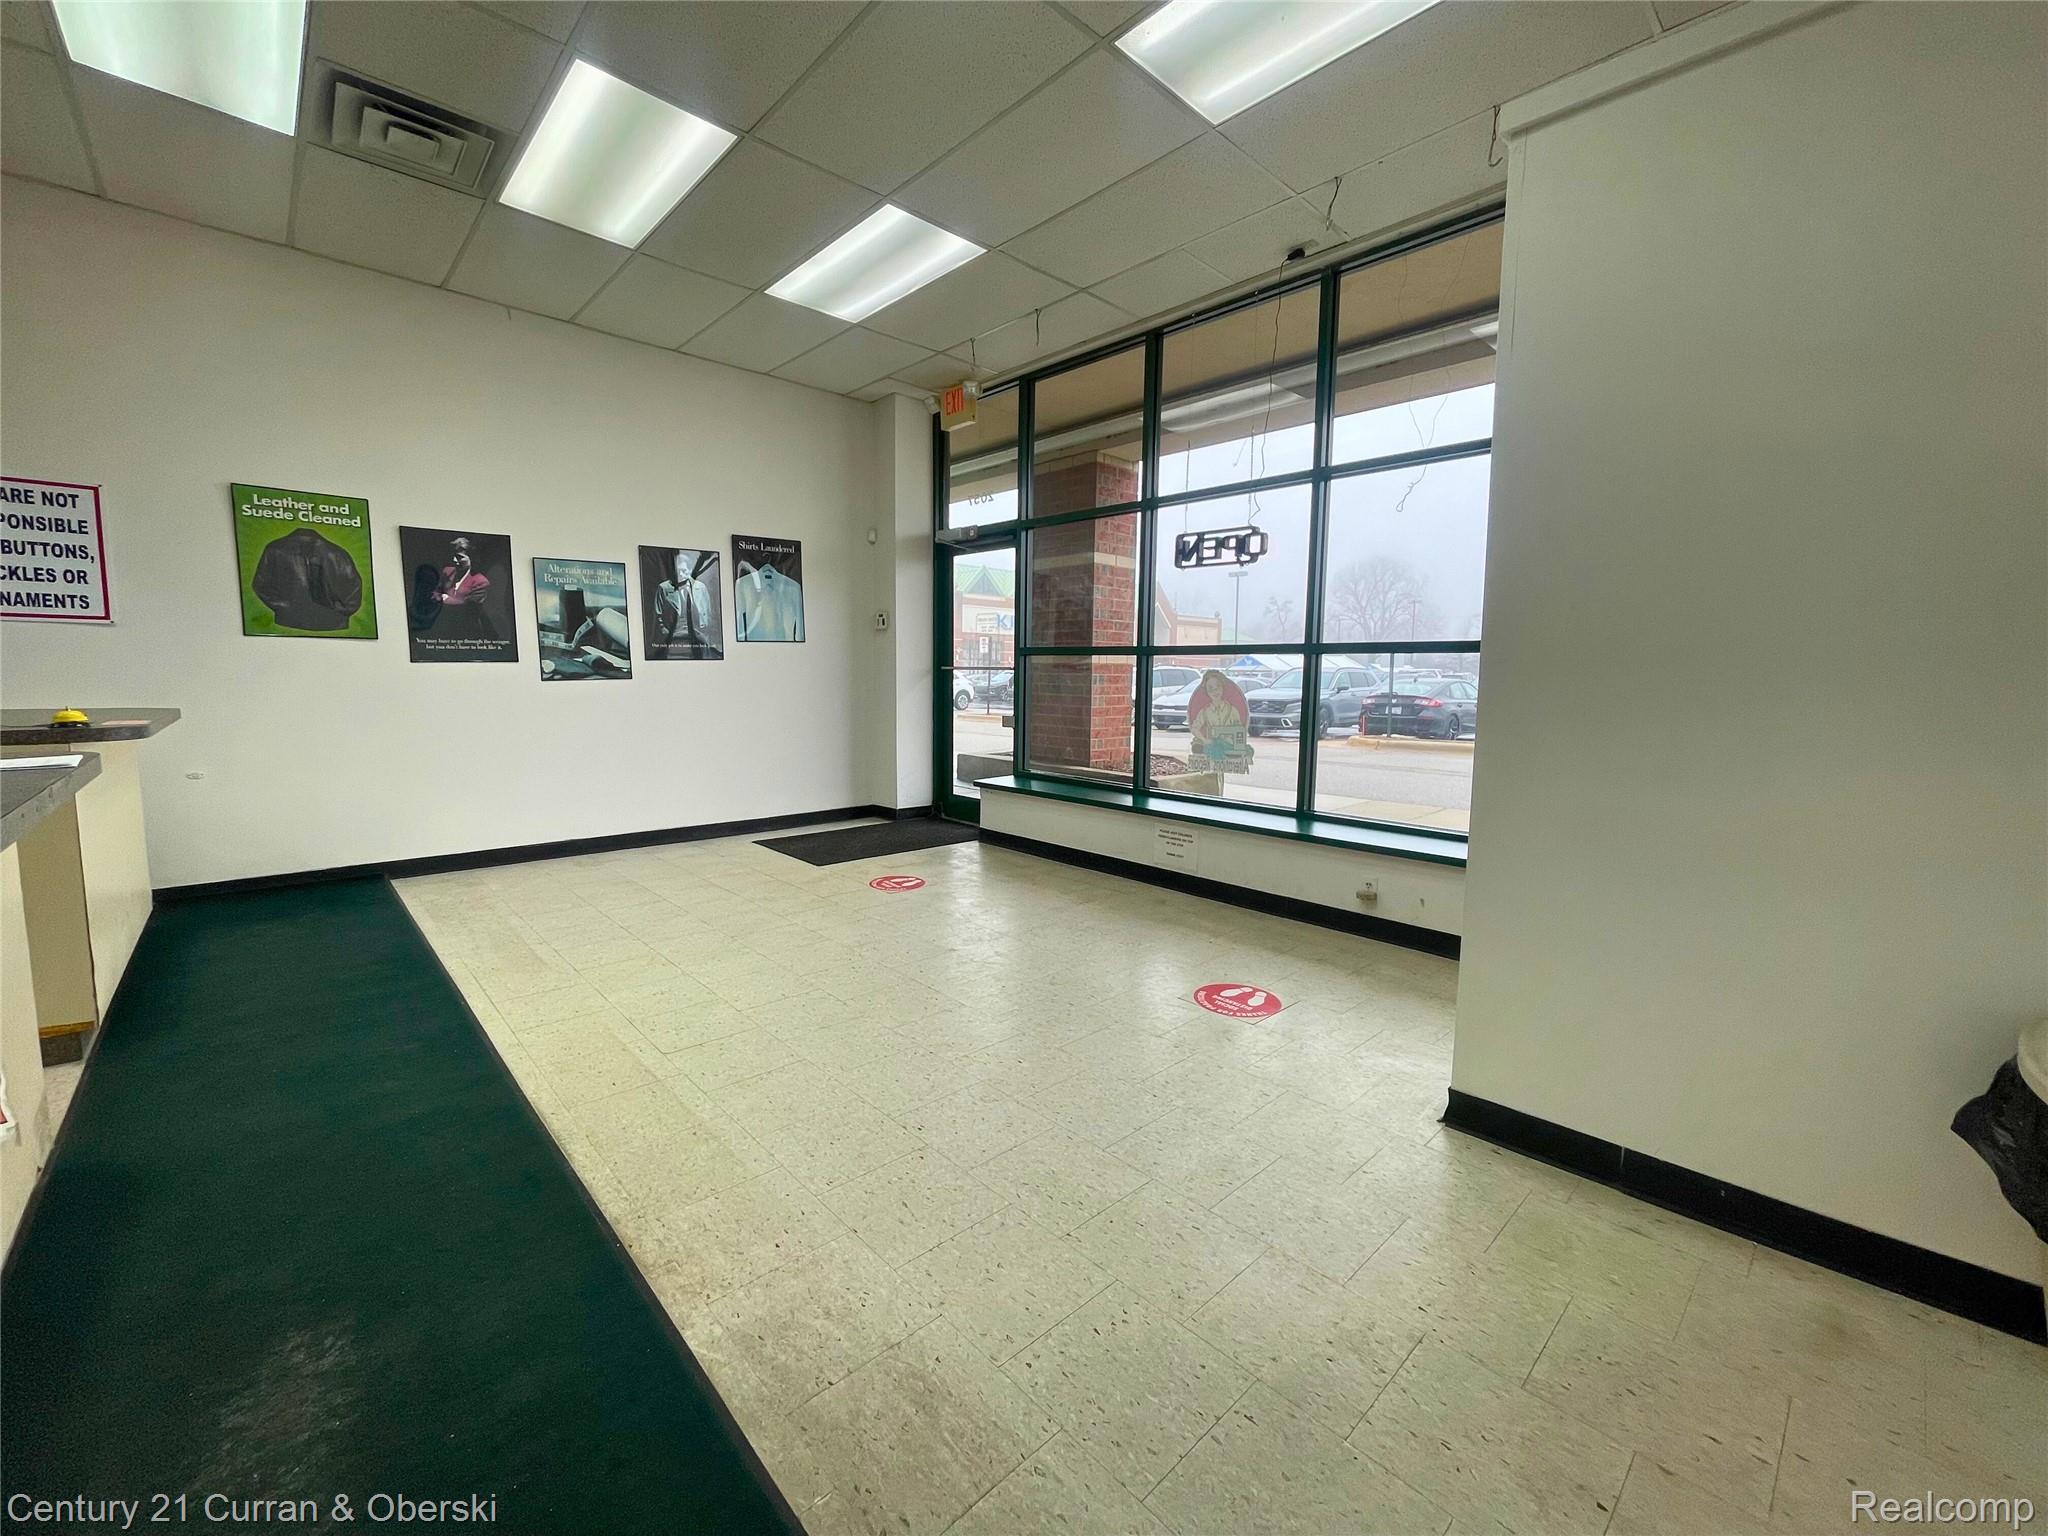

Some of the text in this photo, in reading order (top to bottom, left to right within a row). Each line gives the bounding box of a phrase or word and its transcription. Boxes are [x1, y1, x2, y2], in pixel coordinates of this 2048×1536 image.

[0, 487, 79, 509] ARE NOT
[253, 493, 350, 515] Leather and
[241, 504, 361, 527] Suede Cleaned
[0, 539, 95, 564] BUTTONS,
[738, 540, 795, 553] Shirts Laundered
[63, 569, 89, 585] OR
[547, 563, 613, 576] Alterations and
[544, 573, 617, 586] Repairs Available
